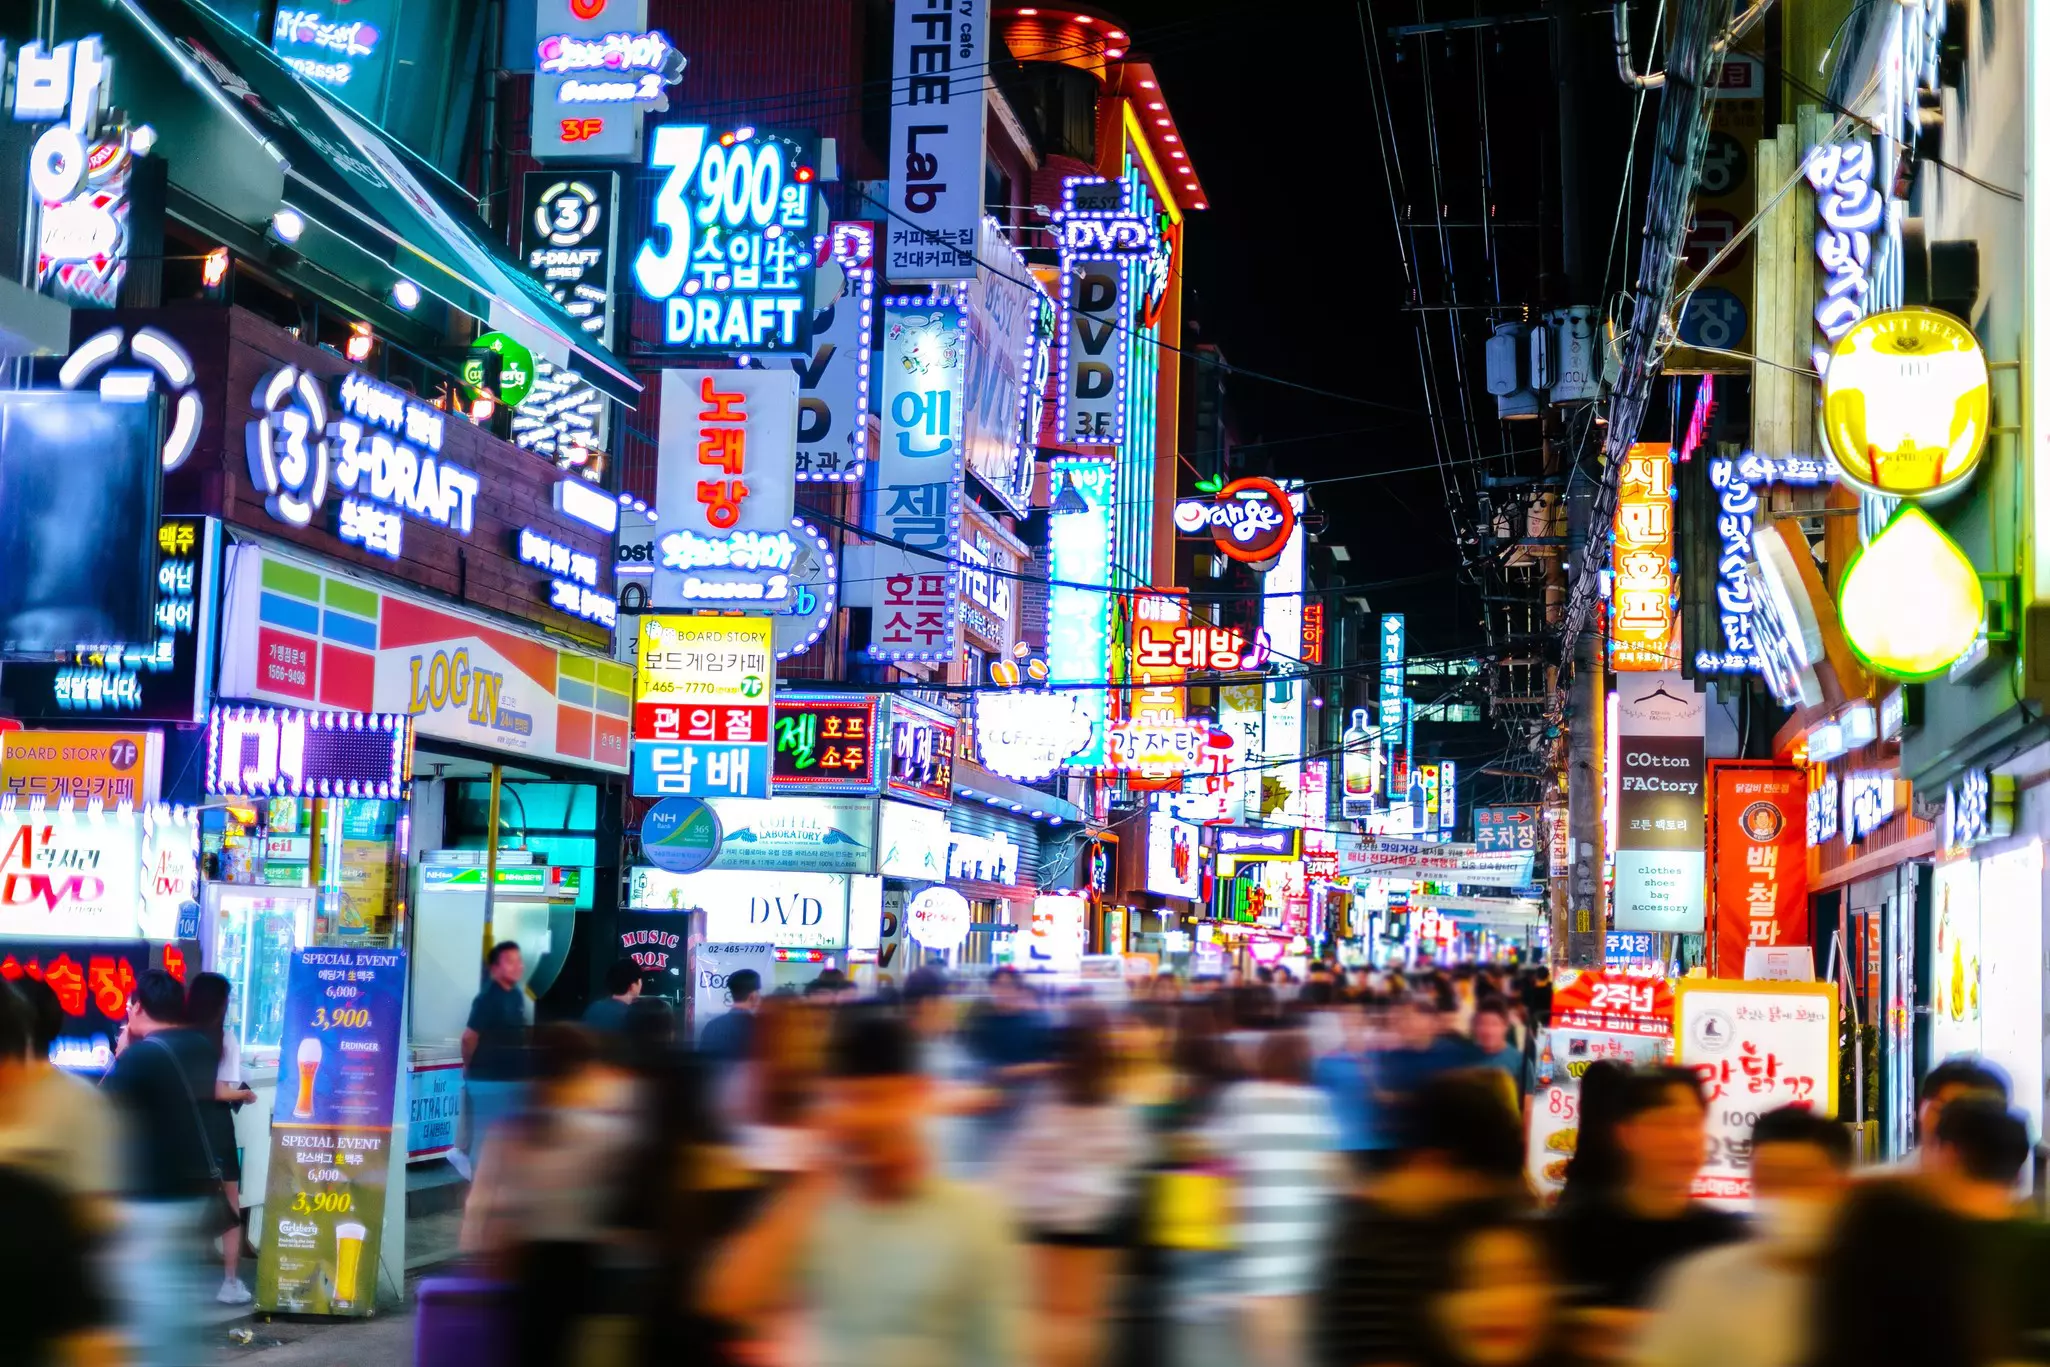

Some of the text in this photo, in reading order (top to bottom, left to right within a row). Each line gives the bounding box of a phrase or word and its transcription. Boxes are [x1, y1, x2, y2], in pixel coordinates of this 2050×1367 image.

[959, 23, 975, 60] cafe
[0, 33, 104, 197] 방
[561, 118, 603, 142] 3F
[904, 124, 949, 214] Lab
[893, 228, 974, 247] 커피볶는집
[1066, 220, 1148, 250] DVD
[530, 249, 602, 269] 3-DRAFT
[892, 250, 973, 268] 건대커피랩
[666, 296, 804, 345] DRAFT
[1075, 273, 1118, 399] DVD
[1075, 411, 1111, 436] 3F
[697, 375, 750, 529] 노래방
[336, 421, 478, 533] 3-DRAFT
[882, 389, 954, 553] 엔젤
[1174, 499, 1284, 542] Orange
[159, 523, 195, 555] 맥주
[1617, 456, 1671, 632] 시민호프
[159, 563, 193, 593] 아닌
[884, 573, 946, 607] 호프
[678, 632, 767, 643] BOARD STORY
[882, 611, 945, 646] 소주
[268, 643, 307, 667] 가맹점문의
[1137, 625, 1245, 670] 노래방
[644, 652, 765, 673] 보드게임카페
[267, 663, 306, 687] 1566-9498
[644, 681, 715, 693] T.465-7770
[741, 679, 763, 695] 7F
[653, 707, 753, 741] 편의점
[821, 716, 866, 739] 호프
[774, 713, 818, 770] 젤
[1112, 731, 1203, 760] 감자탕
[5, 744, 136, 766] BOARD STORY 7F
[821, 746, 866, 771] 소주
[1625, 752, 1691, 768] COtton
[652, 746, 751, 796] 담배
[7, 776, 135, 800] 보드게임카페
[1622, 777, 1699, 796] FACtory
[652, 812, 677, 823] NH
[693, 825, 710, 834] 365
[1630, 819, 1688, 832] 코튼 팩토리
[1478, 825, 1536, 850] 주차장
[1638, 866, 1682, 875] clothes
[1, 872, 105, 914] DVD
[1644, 879, 1675, 887] shoes
[1650, 890, 1669, 901] bag
[749, 892, 823, 927] DVD
[1631, 903, 1688, 914] accessory
[179, 919, 195, 934] 104
[621, 929, 680, 949] MUSIC
[707, 945, 766, 954] 02-465-7770
[1606, 935, 1650, 953] 주차장
[302, 953, 399, 967] SPECIAL EVENT
[630, 951, 670, 968] BOX
[318, 970, 346, 981] 에딩거
[325, 986, 357, 999] 6,000
[1591, 983, 1654, 1013] 2주년
[340, 1040, 379, 1052] ERDINGER
[411, 1096, 442, 1121] EXTRA
[281, 1135, 381, 1150] SPECIAL EVENT
[307, 1168, 339, 1183] 6,000
[279, 1220, 318, 1237] Carlsberg
